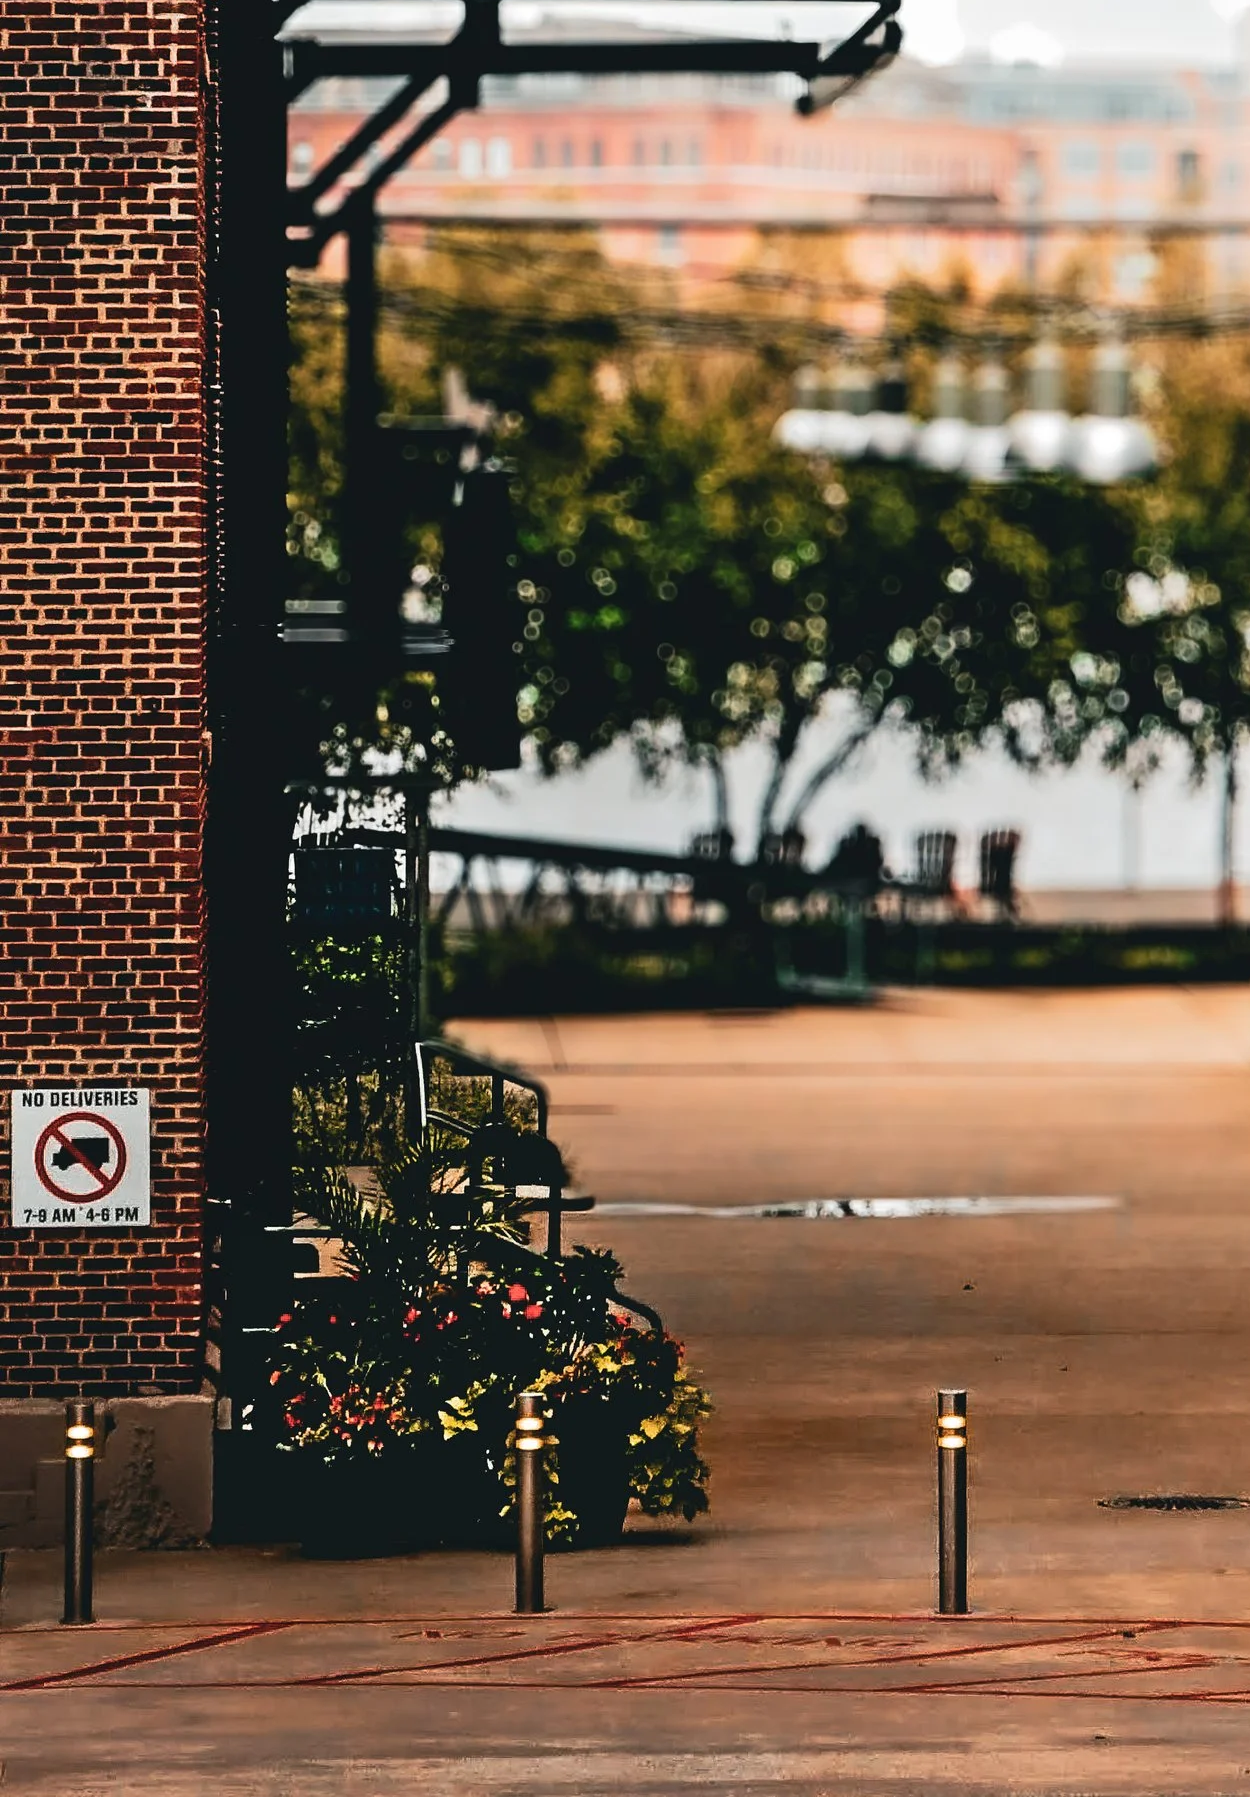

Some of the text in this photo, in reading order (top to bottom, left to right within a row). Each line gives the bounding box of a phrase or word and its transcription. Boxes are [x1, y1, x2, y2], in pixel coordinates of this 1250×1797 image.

[22, 1090, 138, 1108] NO DELIVERIES
[52, 1207, 76, 1223] AM
[115, 1206, 139, 1222] PM
